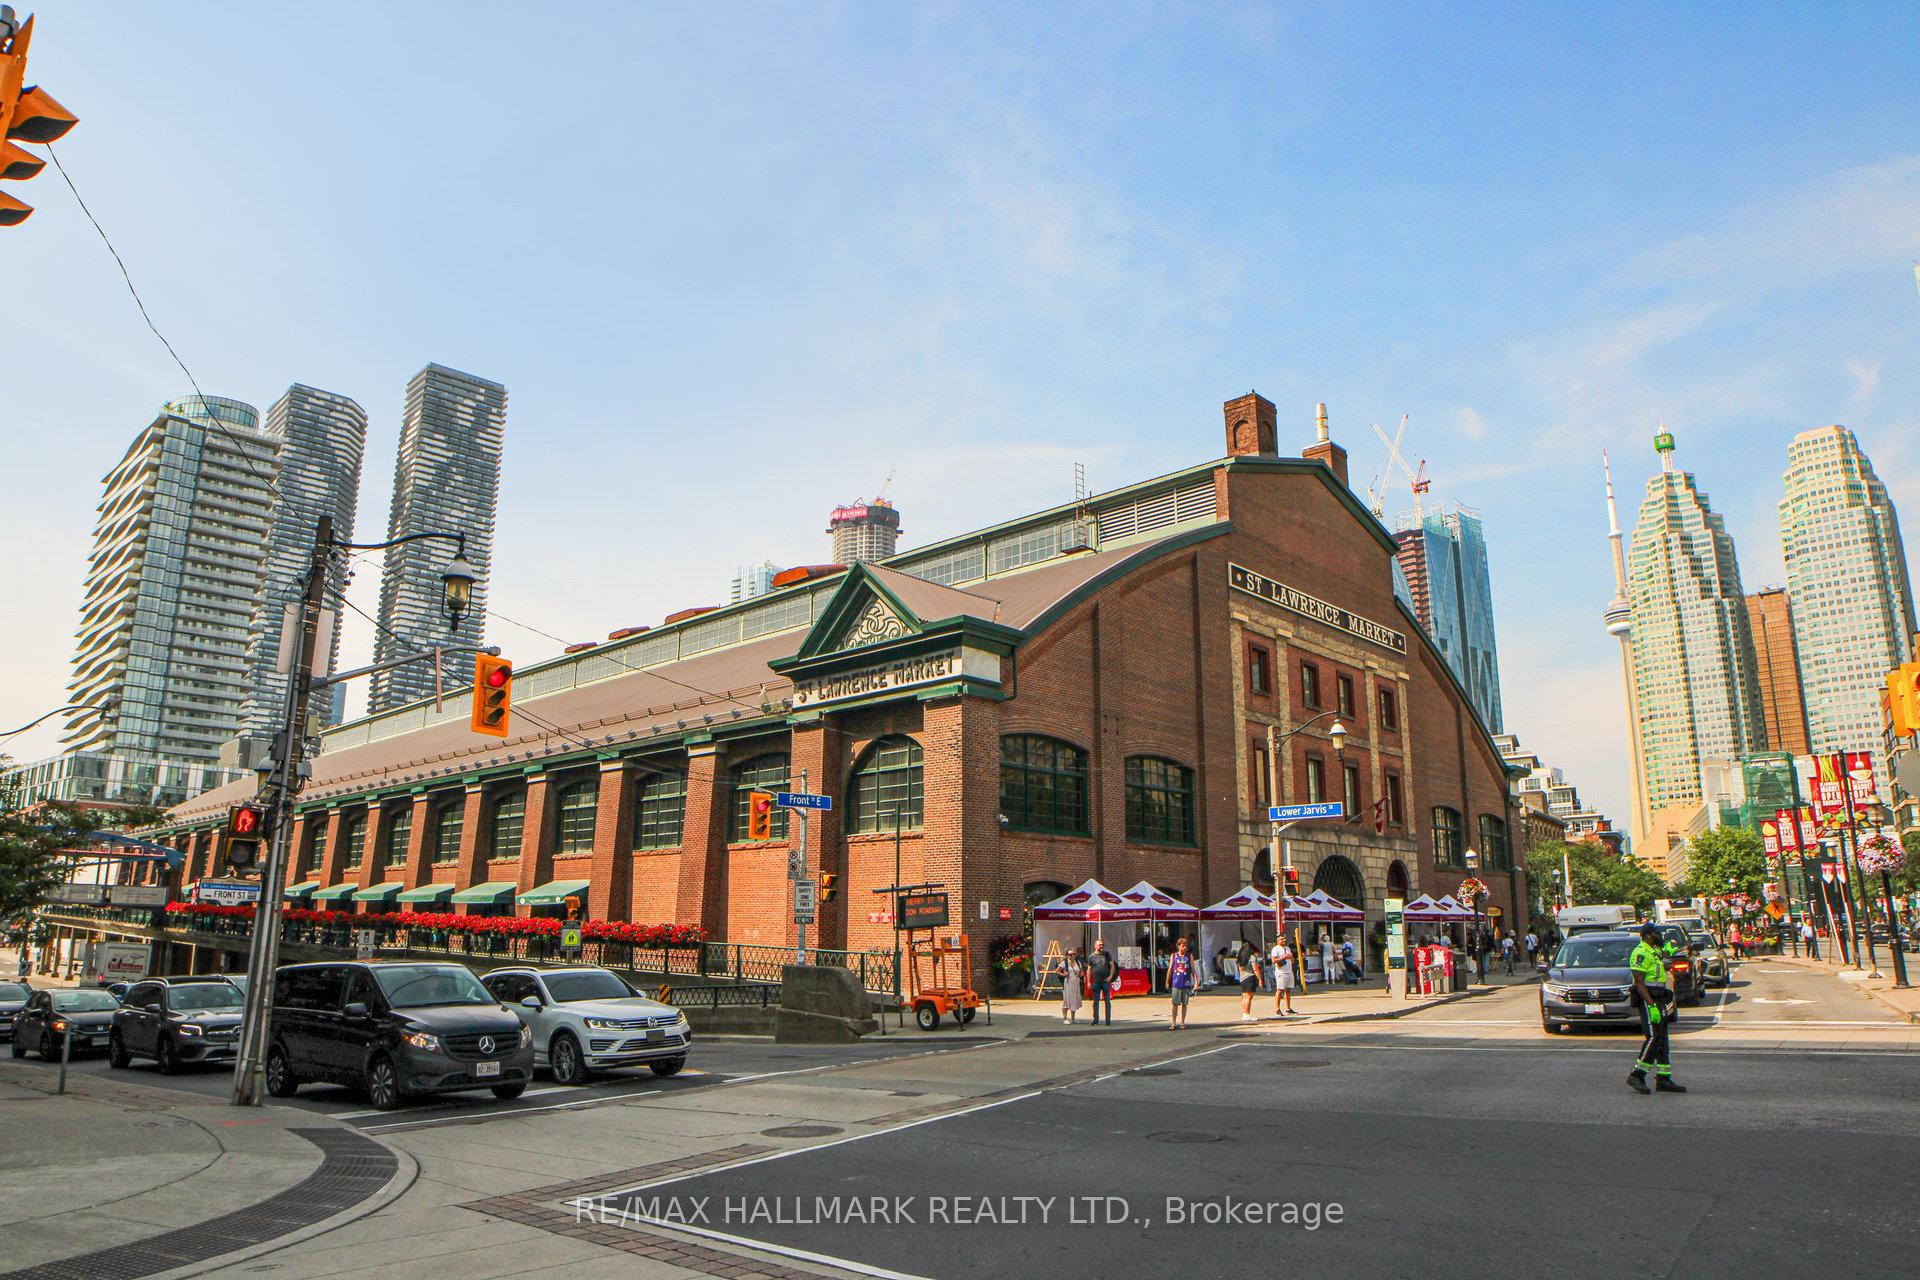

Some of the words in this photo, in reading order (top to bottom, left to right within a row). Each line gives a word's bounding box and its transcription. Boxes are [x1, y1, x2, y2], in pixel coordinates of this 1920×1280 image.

[1271, 583, 1340, 626] LAWRENCE
[1348, 614, 1395, 647] MARKET
[818, 666, 888, 701] LAWRENCE
[894, 651, 955, 685] MARKET
[789, 794, 810, 805] Front
[816, 797, 821, 806] E
[1277, 807, 1301, 817] Lower
[1303, 804, 1327, 815] Jarvis
[213, 890, 236, 899] FRONT
